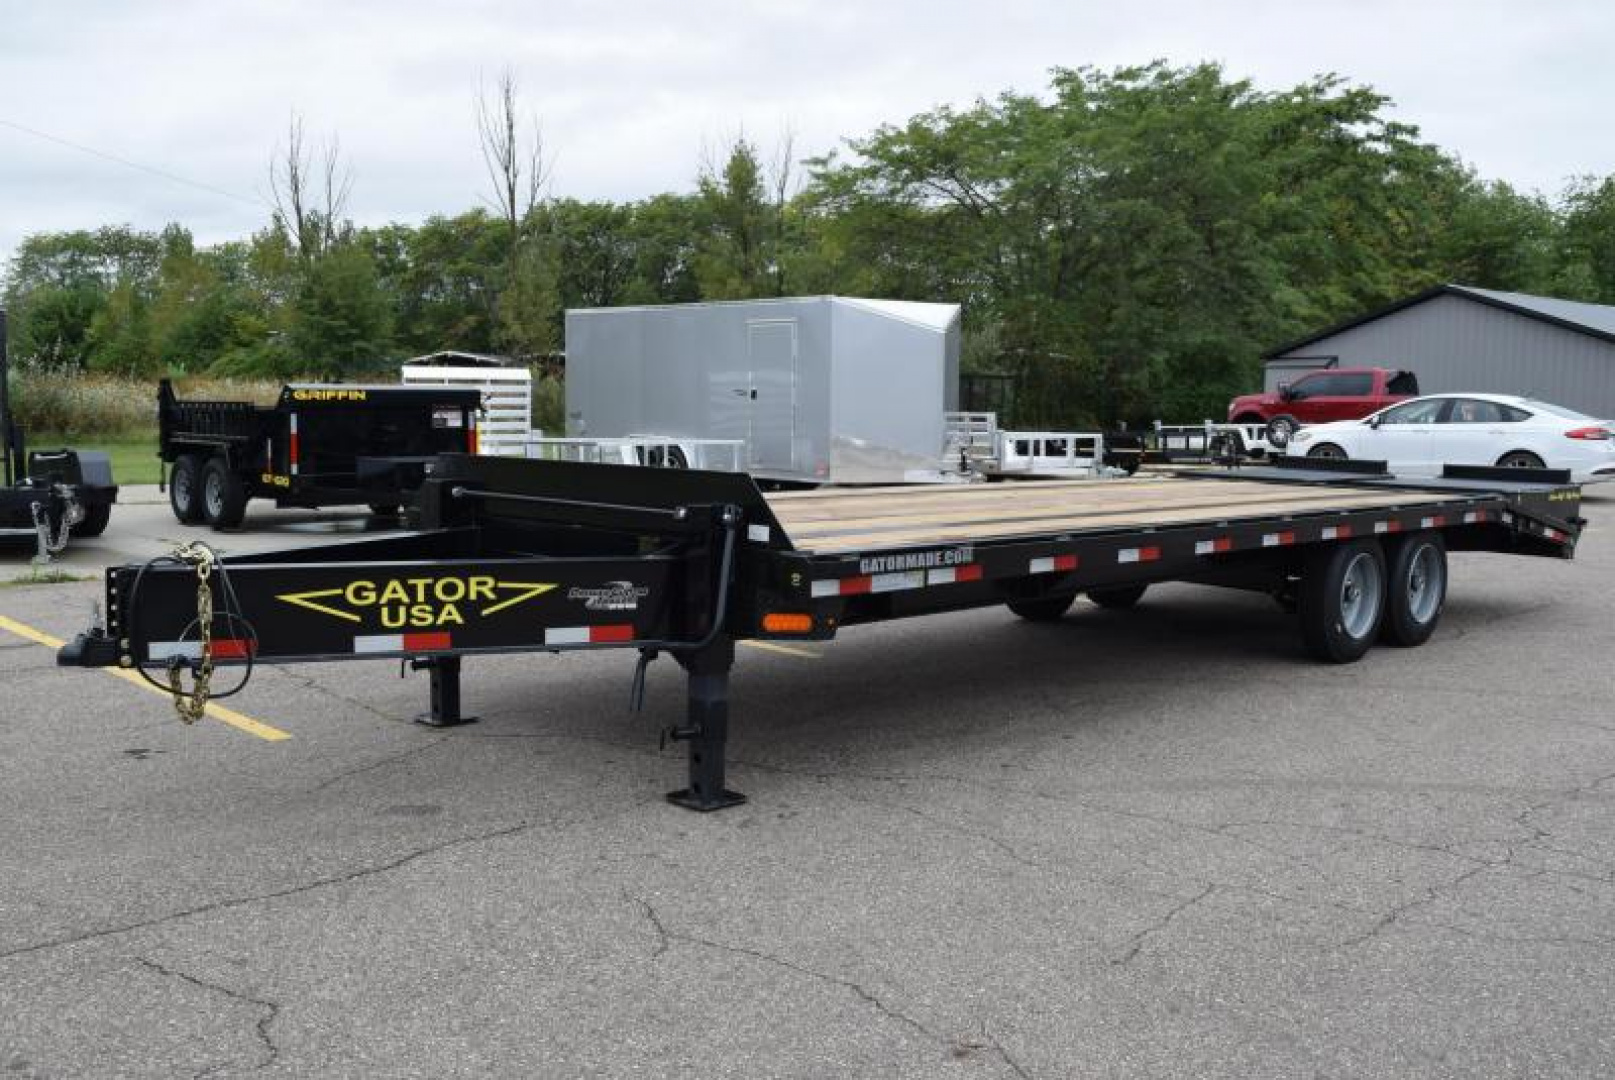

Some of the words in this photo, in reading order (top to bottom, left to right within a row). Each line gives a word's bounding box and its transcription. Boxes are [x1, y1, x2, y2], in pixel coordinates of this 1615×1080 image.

[293, 389, 366, 401] GRIFFIN
[860, 548, 972, 573] GATORMADE.COM
[345, 577, 497, 605] GATOR
[380, 604, 464, 627] USA
